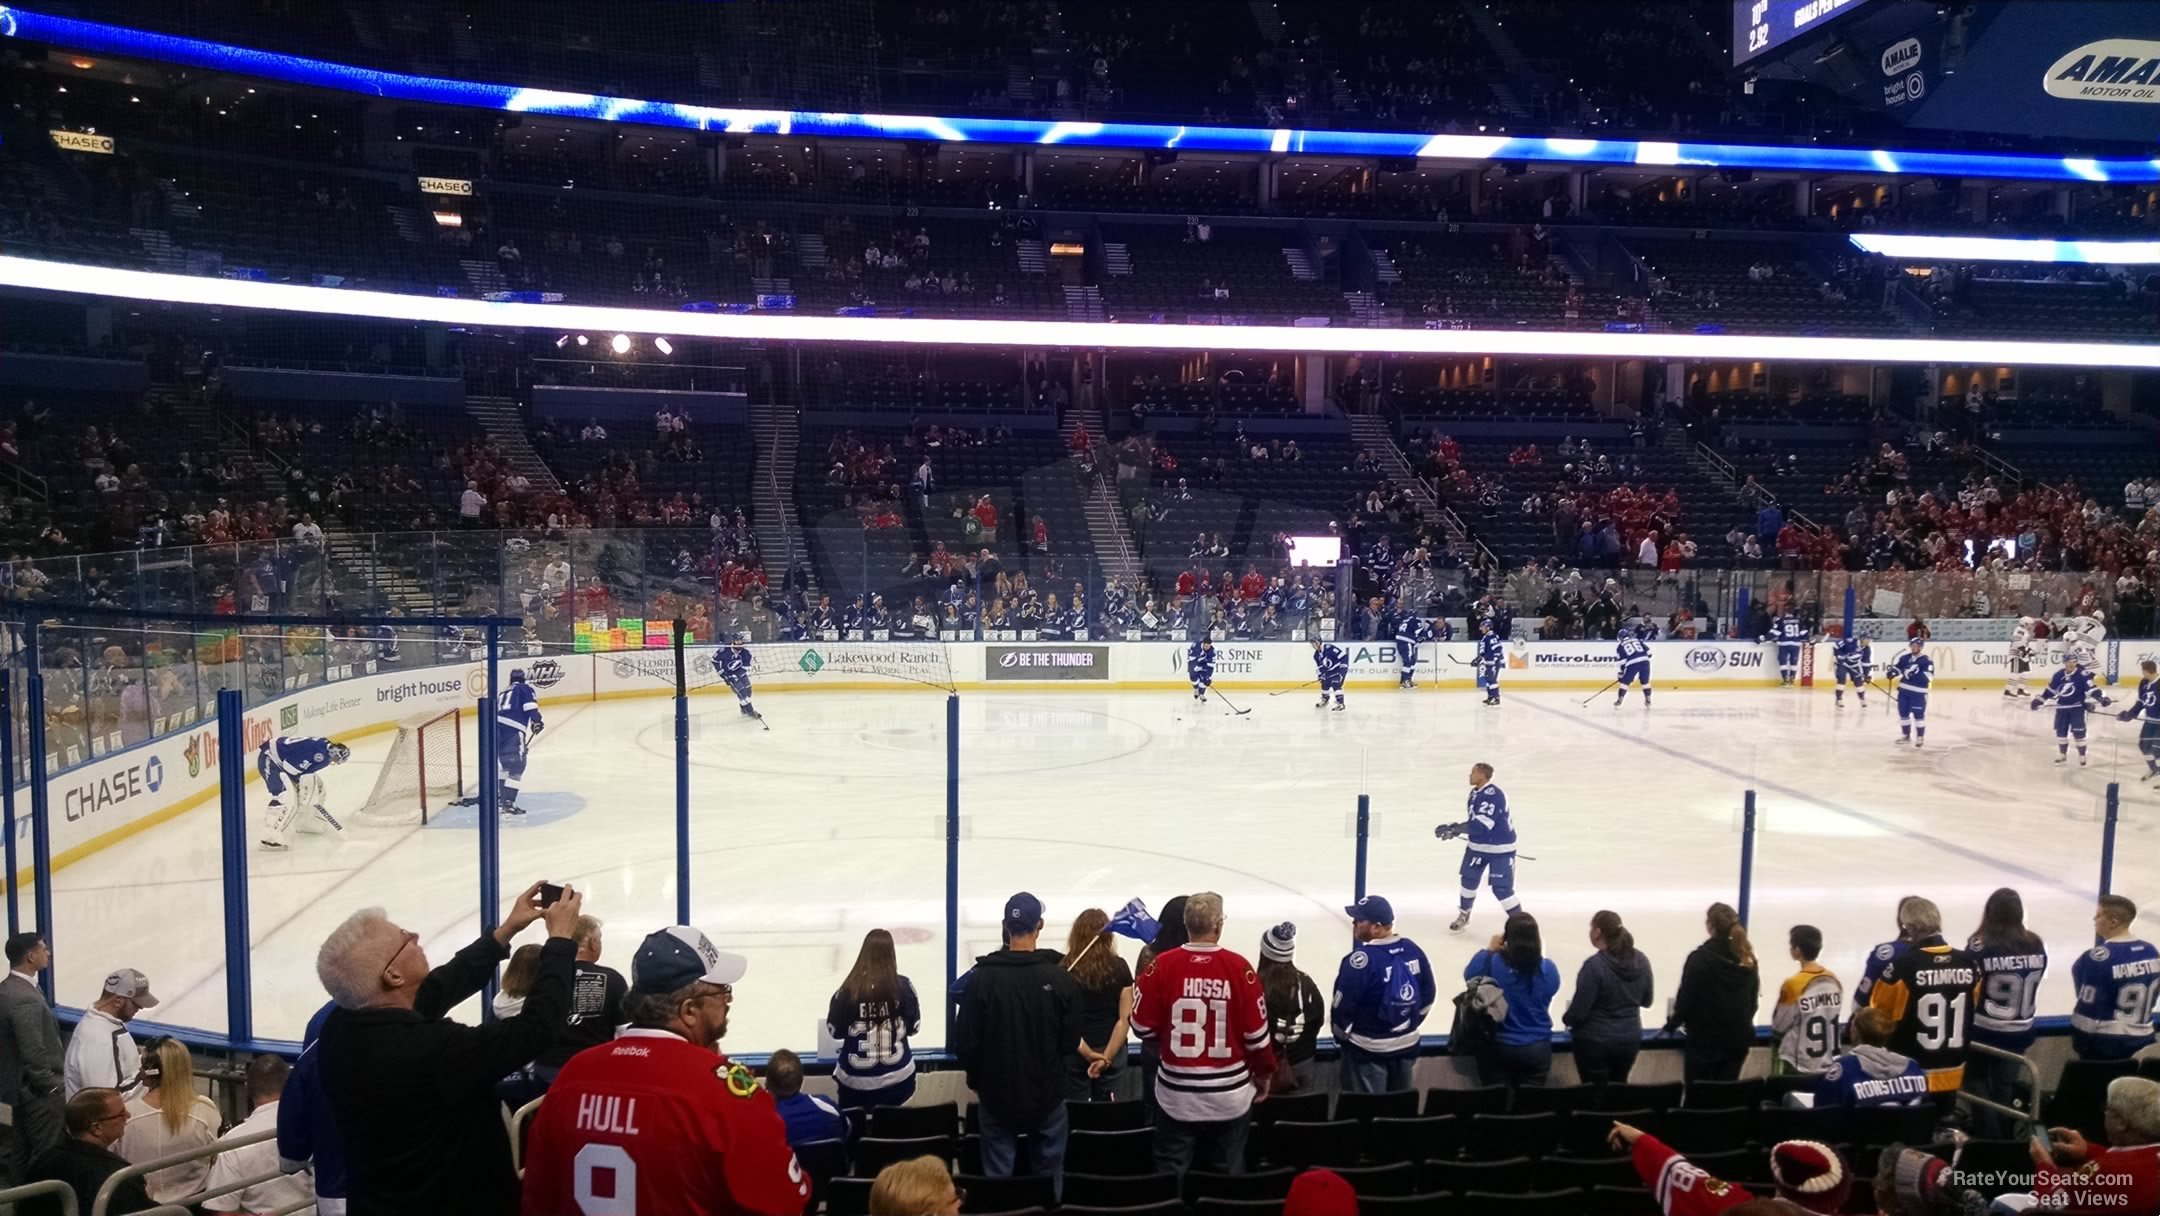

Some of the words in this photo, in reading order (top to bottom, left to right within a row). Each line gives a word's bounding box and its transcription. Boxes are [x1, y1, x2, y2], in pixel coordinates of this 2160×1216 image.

[1749, 24, 1769, 52] 2.92
[1885, 43, 1918, 70] AMALIE
[1884, 80, 1905, 96] bright
[2080, 87, 2131, 97] MOTOR
[2133, 89, 2155, 98] OIL
[1885, 92, 1906, 106] house
[420, 181, 461, 192] CHASE
[1785, 624, 1800, 637] 91
[2083, 622, 2095, 634] 7
[1229, 649, 1262, 661] SPINE
[1623, 642, 1644, 656] 86
[1693, 651, 1717, 663] FOX
[828, 652, 896, 664] Lakewood
[900, 652, 939, 664] Ranch
[1019, 653, 1031, 666] BE
[1033, 653, 1050, 666] THE
[1051, 653, 1093, 666] THUNDER
[1535, 653, 1618, 663] MicroLum
[1729, 651, 1763, 667] SUN
[2108, 641, 2117, 676] Reebok
[525, 665, 566, 681] NHL
[376, 683, 417, 704] bright
[419, 679, 462, 694] house
[303, 705, 325, 719] Making
[326, 701, 338, 713] Life
[340, 697, 362, 710] Better
[65, 765, 142, 822] CHASE
[1478, 801, 1496, 816] 23
[1915, 968, 1973, 986] STAMKOS
[1183, 977, 1231, 999] HOSSA
[1984, 970, 2042, 1020] 90
[1170, 997, 1232, 1058] 81
[1916, 992, 1967, 1050] 91
[848, 1017, 905, 1070] 30
[1806, 1014, 1841, 1058] 91
[610, 1046, 651, 1058] Reebok
[576, 1093, 640, 1135] HULL
[573, 1142, 637, 1216] 9
